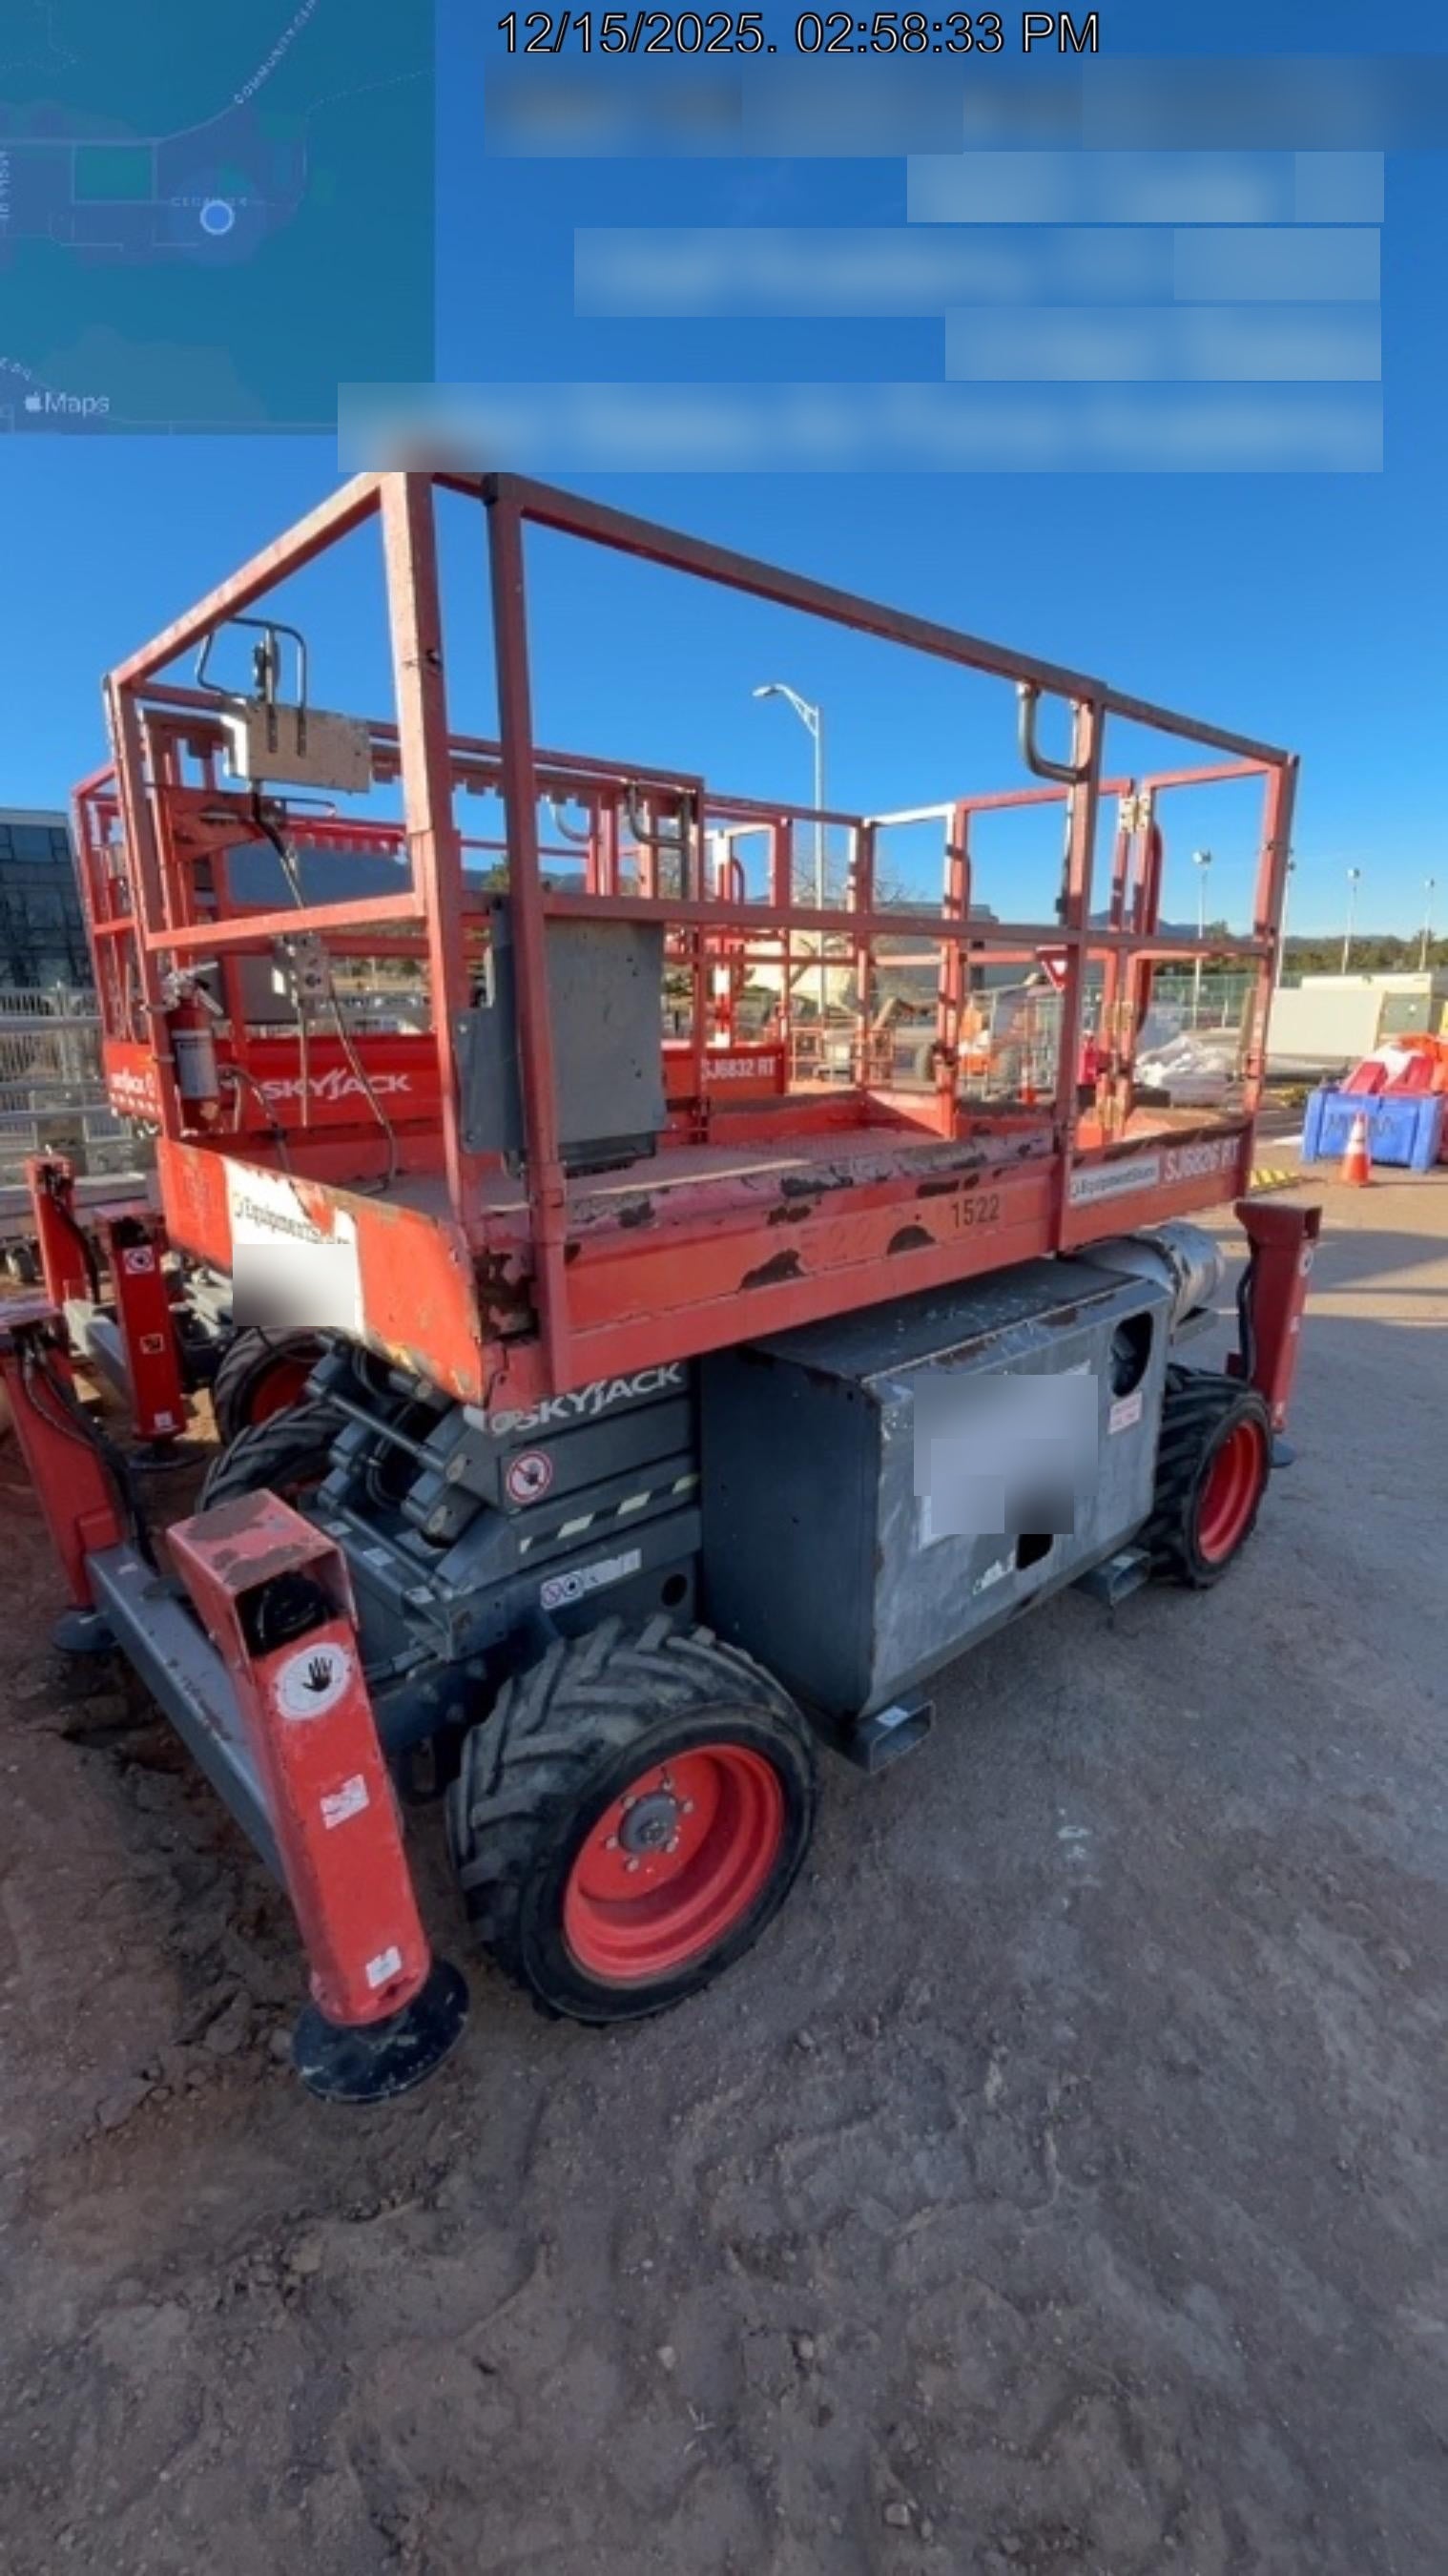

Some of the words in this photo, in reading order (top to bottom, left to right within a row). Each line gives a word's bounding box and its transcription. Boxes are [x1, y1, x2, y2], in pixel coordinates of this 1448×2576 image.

[757, 1055, 776, 1077] RT
[260, 1068, 412, 1101] SKYJACK
[950, 1194, 1000, 1229] 1522
[515, 1361, 683, 1430] SKYJACK
